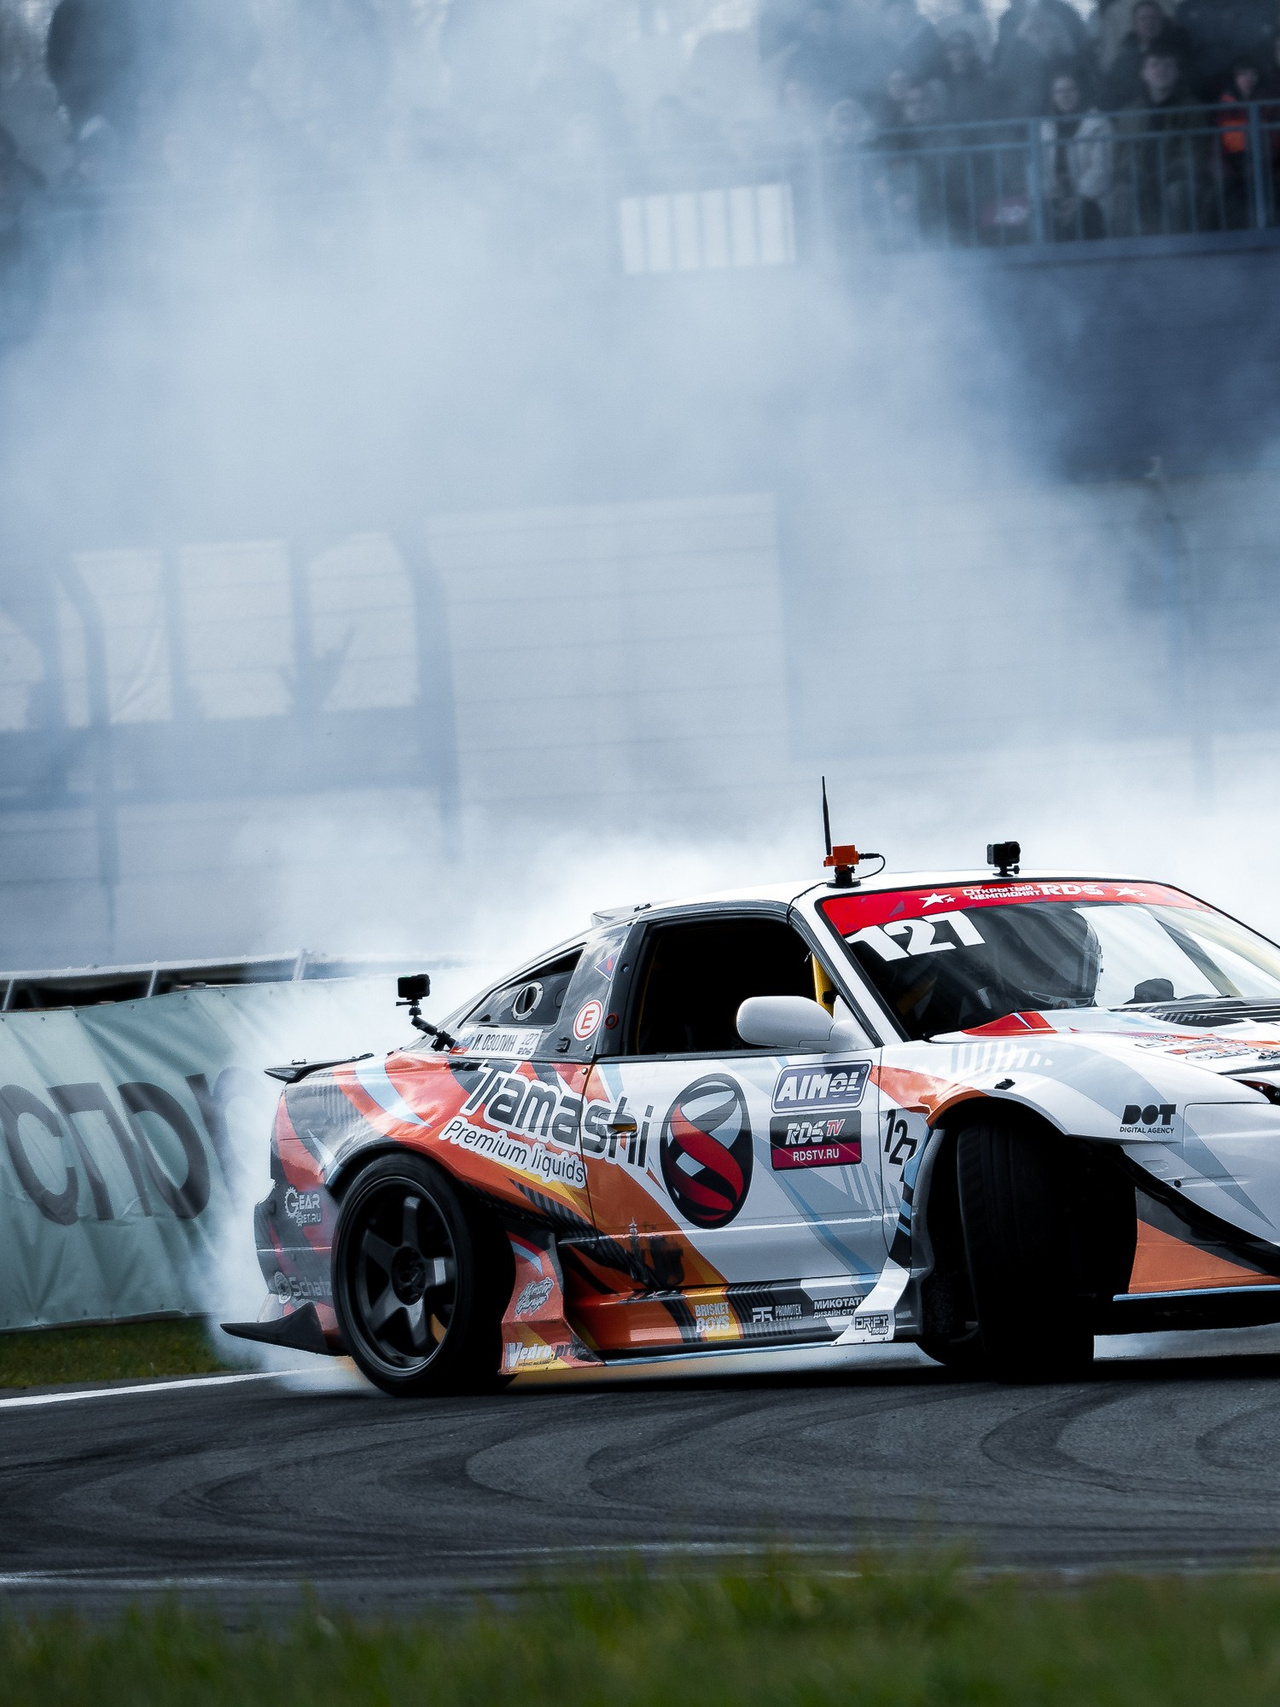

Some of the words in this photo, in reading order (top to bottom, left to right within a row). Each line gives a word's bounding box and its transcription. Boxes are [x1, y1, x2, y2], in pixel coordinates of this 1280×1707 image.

[1037, 884, 1105, 896] RDS
[845, 910, 986, 962] 127
[581, 1010, 595, 1030] E
[776, 1072, 860, 1103] AIMOL
[463, 1059, 654, 1168] Tamashi
[1121, 1104, 1177, 1126] DOT
[1119, 1126, 1146, 1134] DIGITAL
[1147, 1126, 1175, 1134] AGENCY
[444, 1120, 528, 1165] Premium
[531, 1148, 586, 1183] liquids
[793, 1148, 840, 1162] RDSTV.RU
[695, 1302, 730, 1317] BRISKET
[695, 1314, 730, 1333] BOYS
